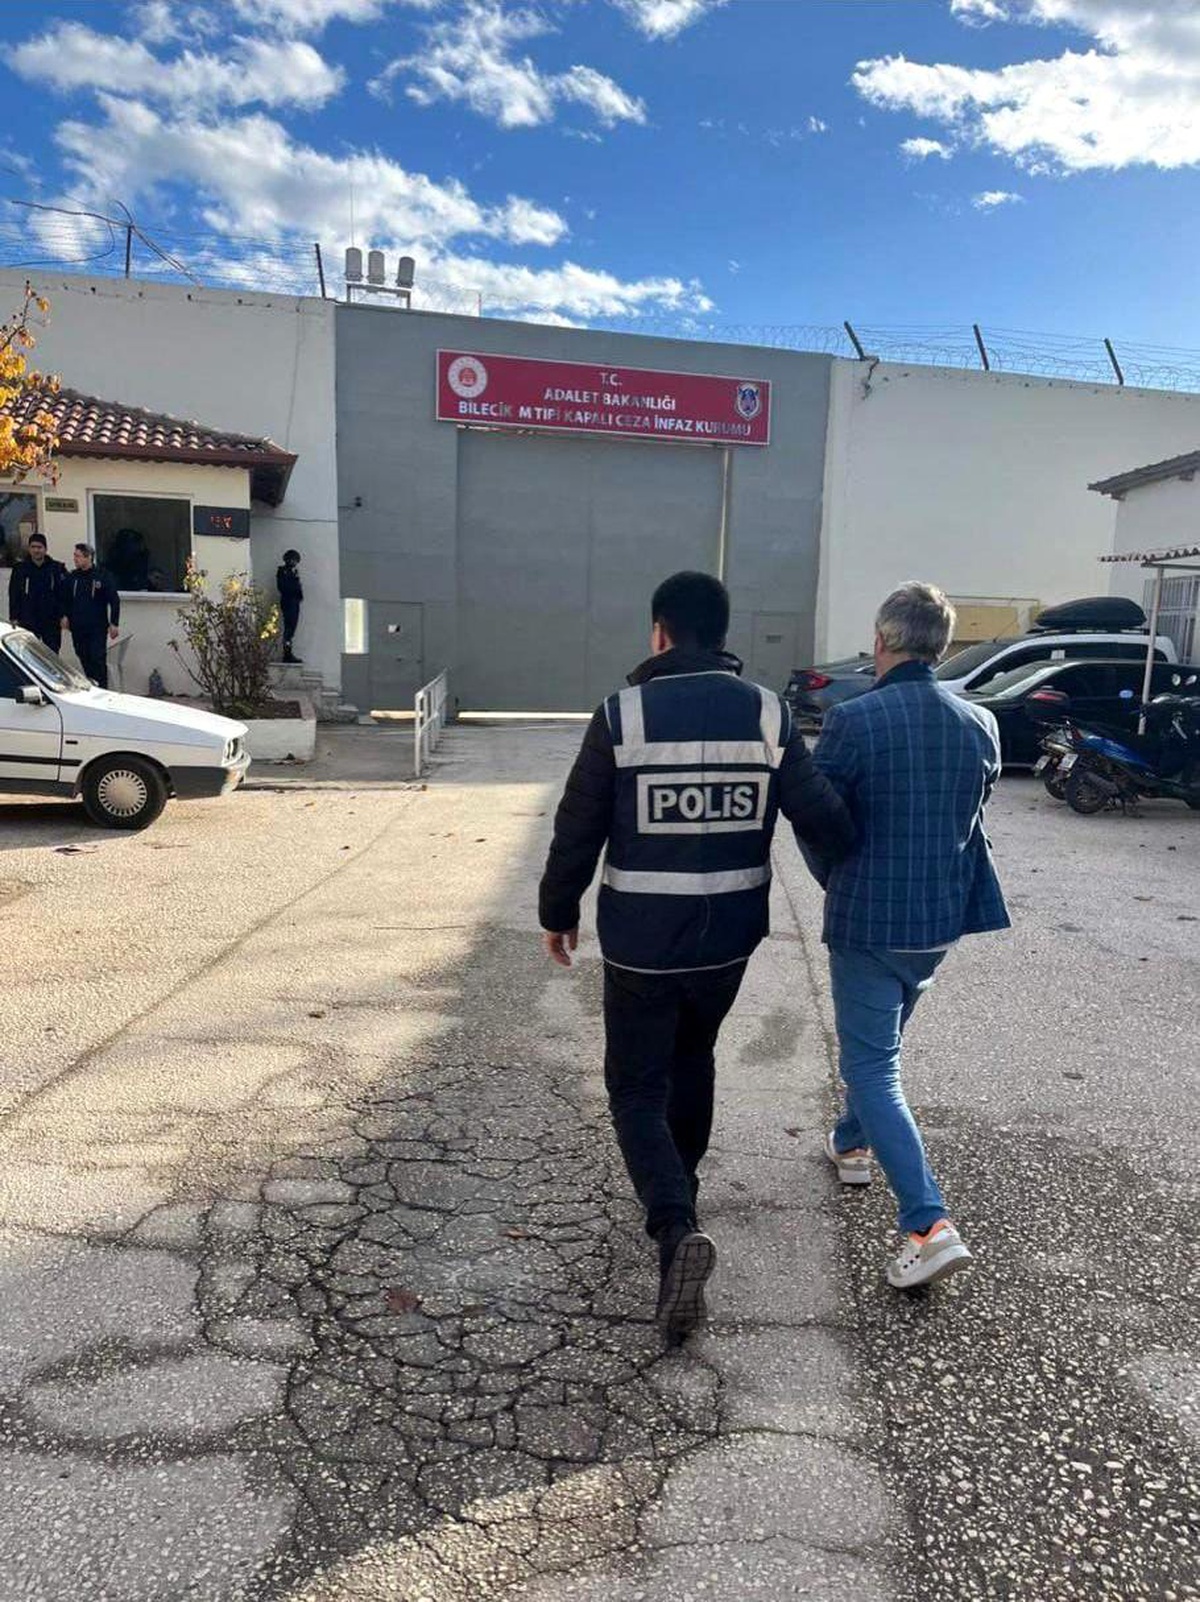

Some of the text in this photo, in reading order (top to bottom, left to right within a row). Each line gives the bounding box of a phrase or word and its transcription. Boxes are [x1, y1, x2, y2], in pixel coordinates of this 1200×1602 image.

[600, 372, 623, 386] T.C.
[544, 388, 676, 411] ADALET BAKANLIĞI
[519, 405, 532, 418] M
[564, 411, 613, 425] KAPALI
[615, 414, 651, 427] CEZA
[654, 414, 693, 431] İNFAZ
[695, 421, 751, 436] KURUMU
